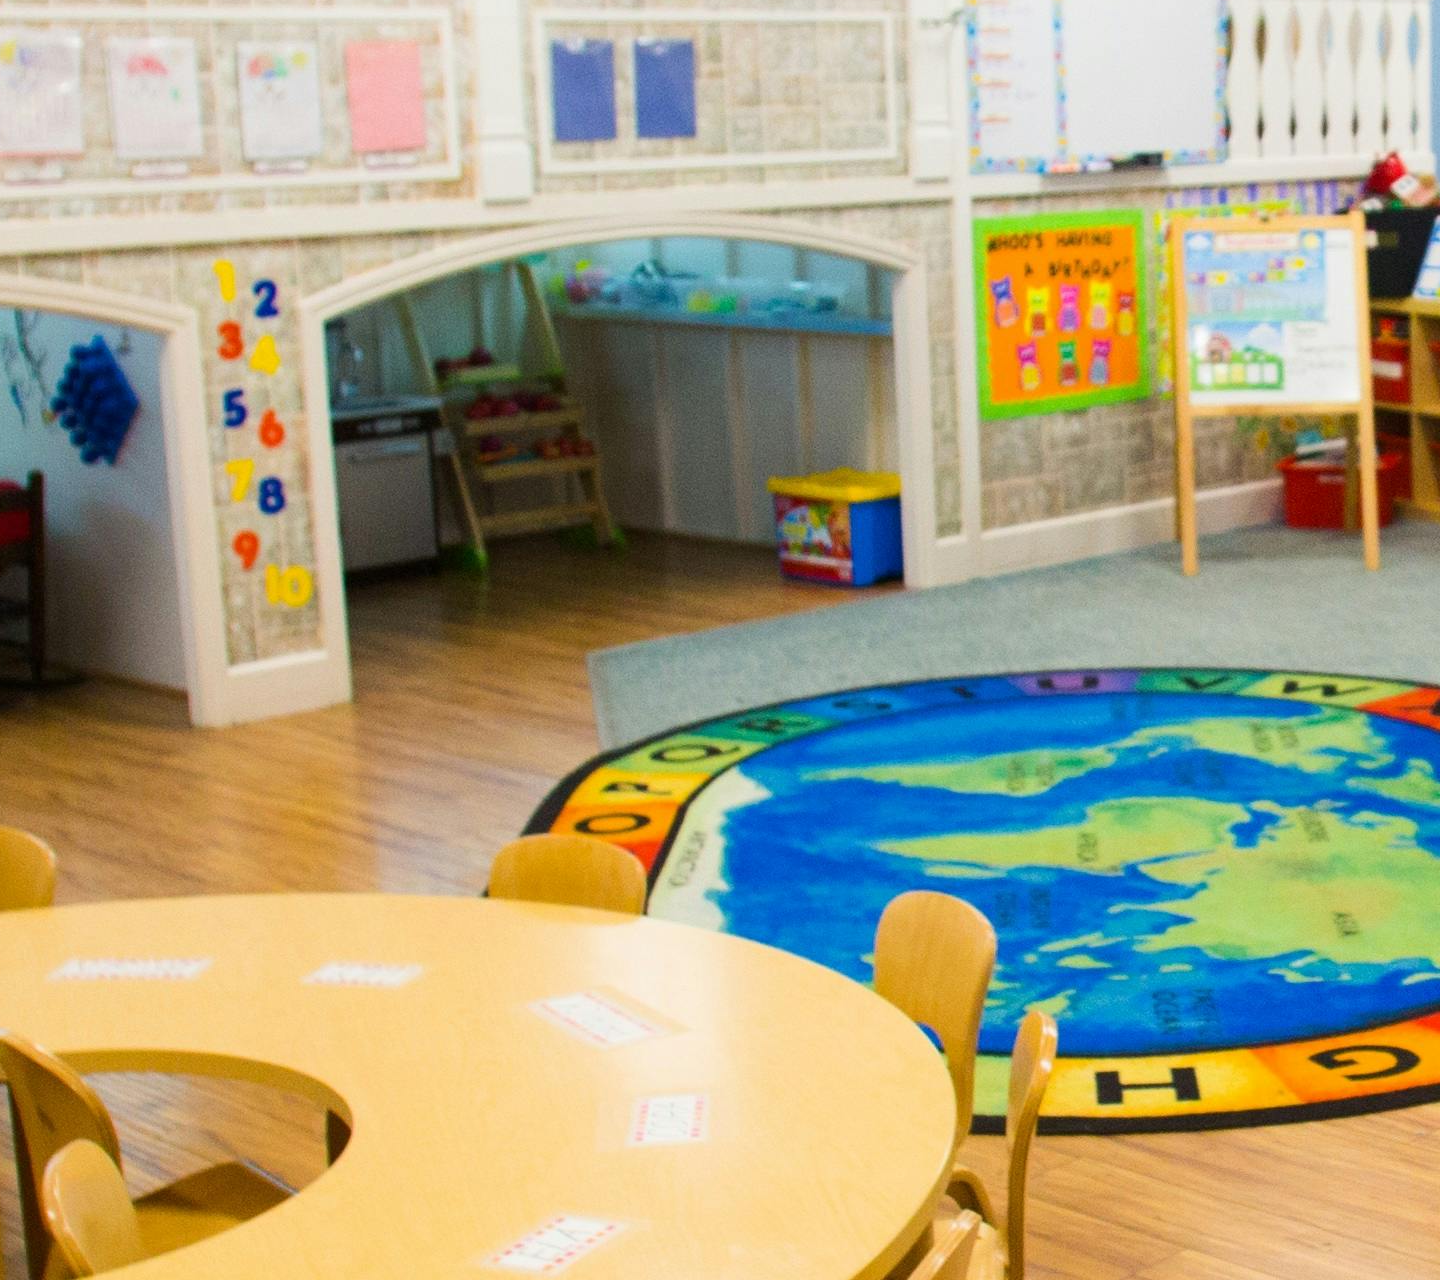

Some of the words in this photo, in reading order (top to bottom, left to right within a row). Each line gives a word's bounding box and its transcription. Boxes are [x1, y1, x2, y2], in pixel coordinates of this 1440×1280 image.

[213, 260, 236, 302] 1
[253, 280, 278, 318] 2
[217, 321, 244, 360] 3
[250, 335, 280, 375] 4
[223, 389, 247, 428] 5
[259, 409, 285, 448] 6
[226, 459, 254, 502] 7
[258, 476, 285, 515] 8
[233, 530, 259, 571] 9
[266, 564, 313, 607] 10
[1179, 674, 1234, 691] V
[1280, 678, 1375, 699] W
[649, 742, 741, 765] Q
[600, 780, 672, 797] P
[573, 812, 651, 834] O
[1308, 1044, 1421, 1081] G
[1094, 1066, 1202, 1106] H
